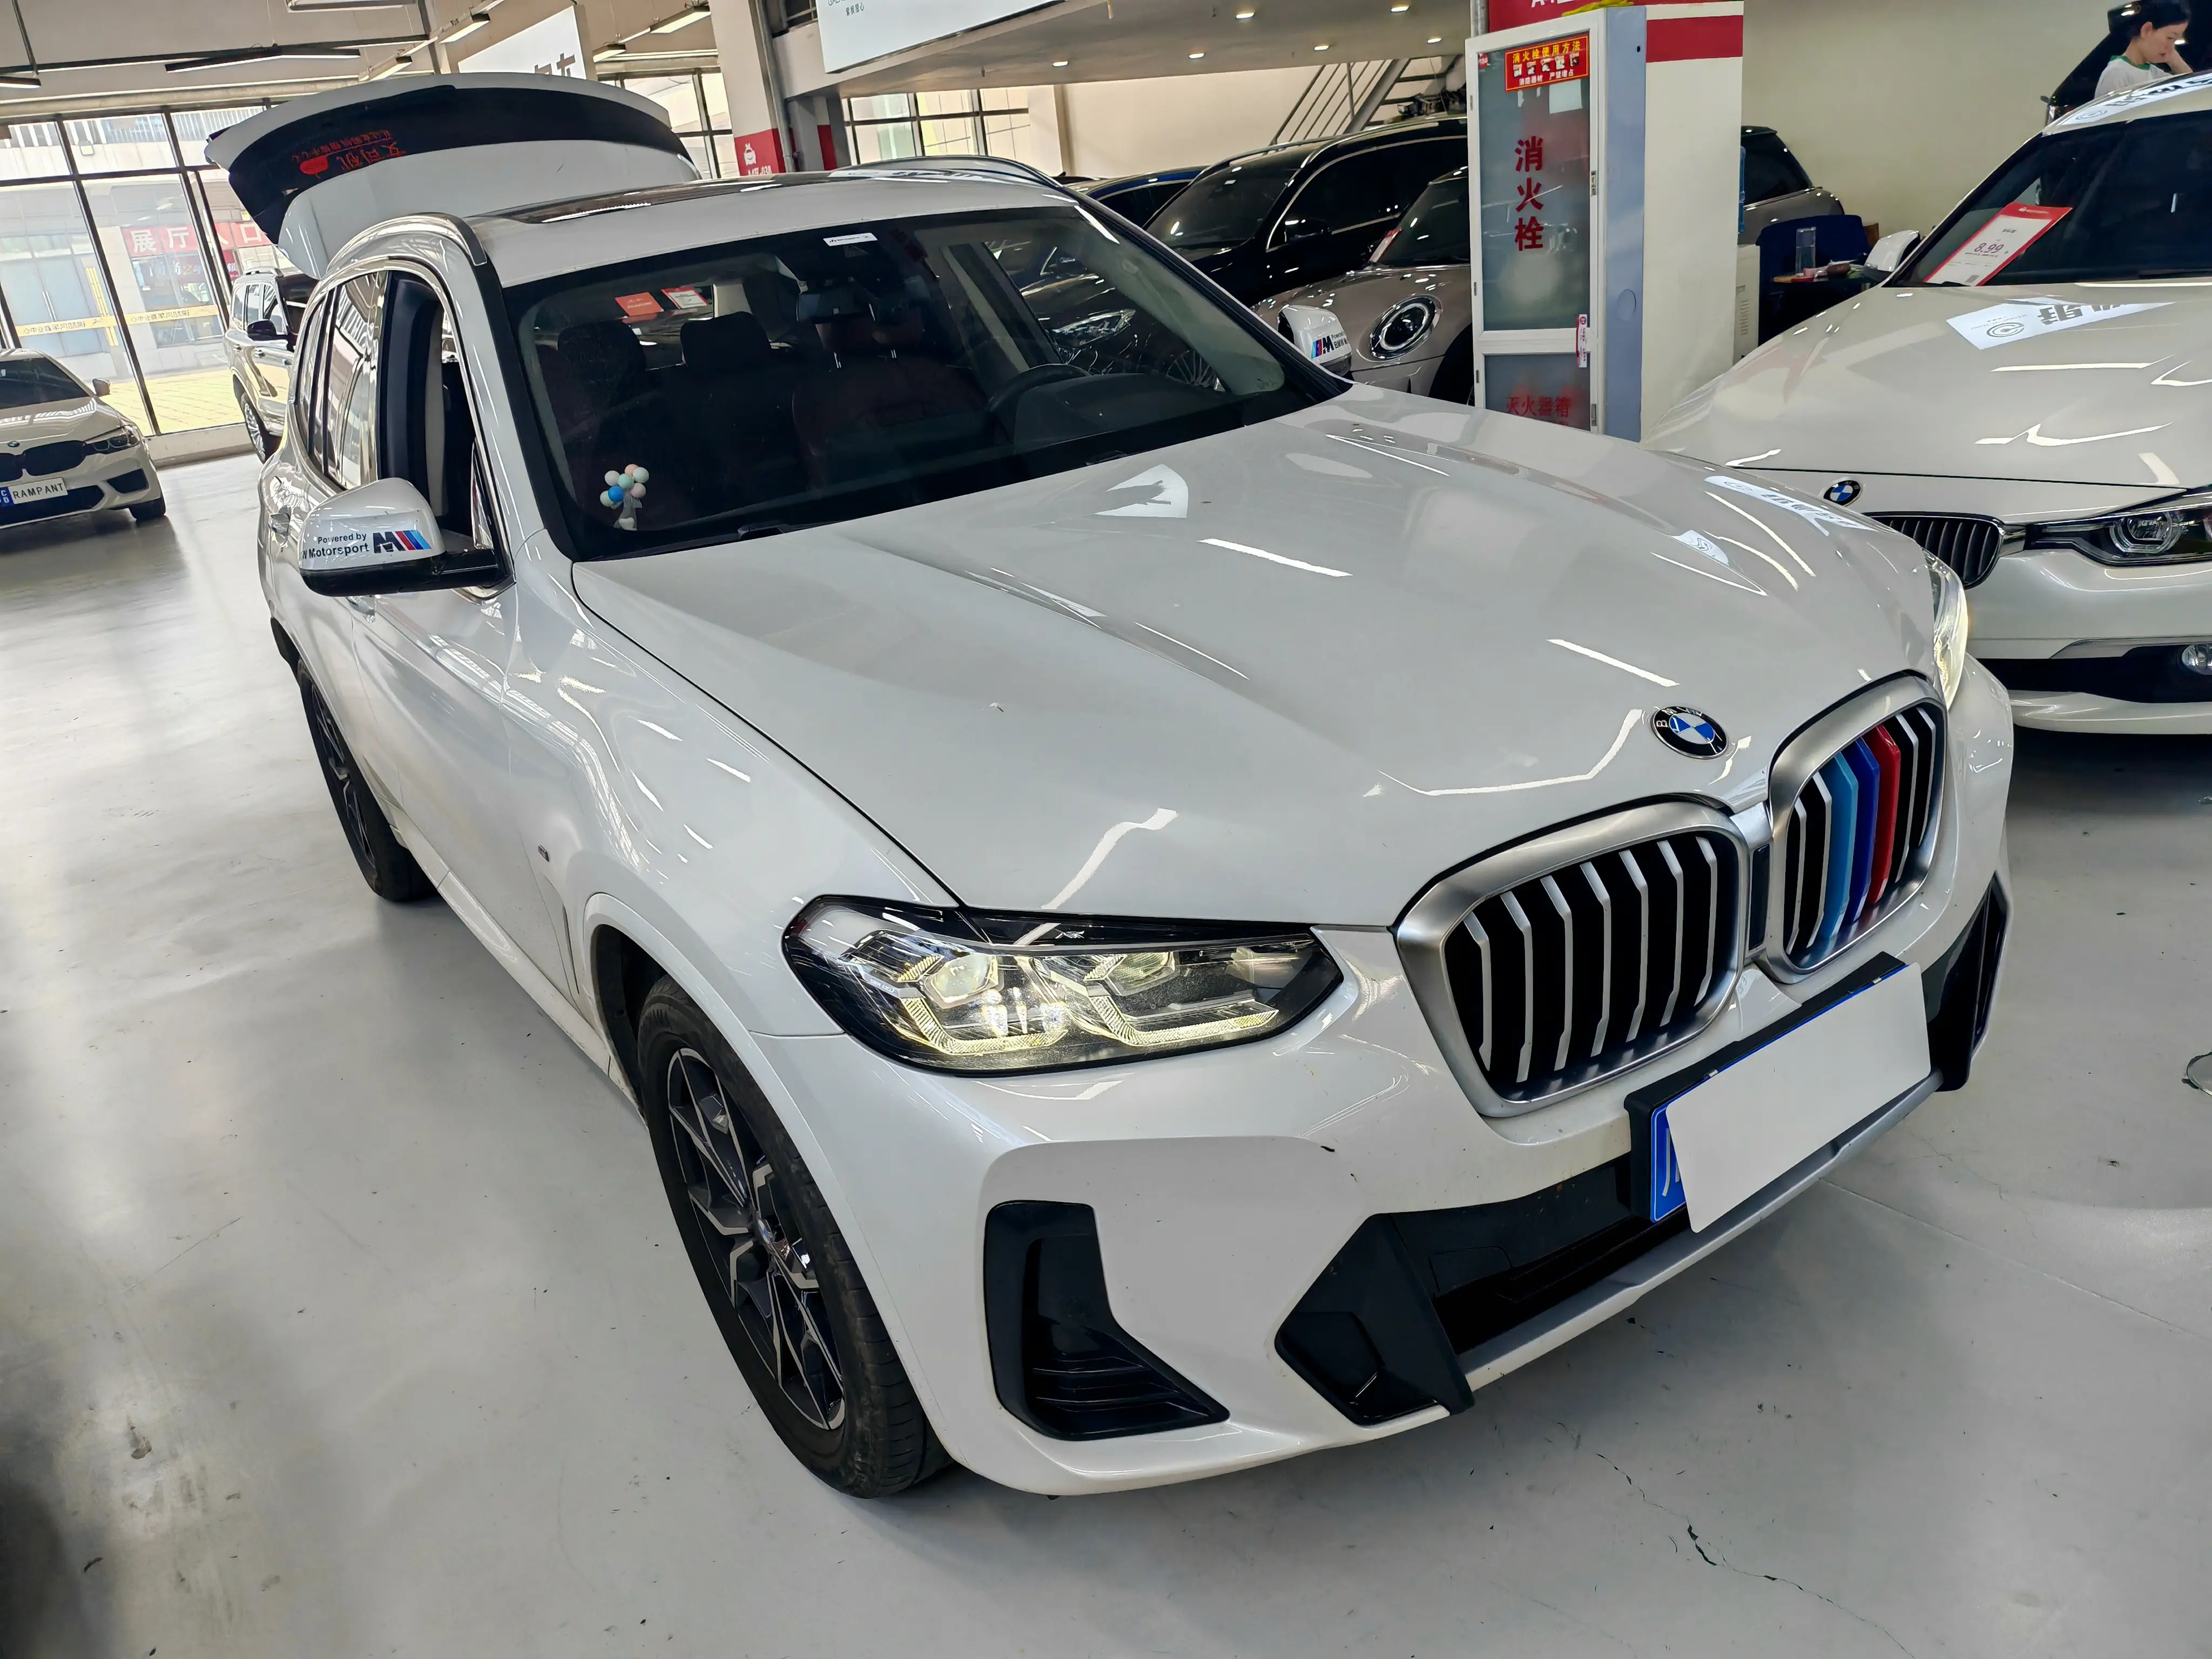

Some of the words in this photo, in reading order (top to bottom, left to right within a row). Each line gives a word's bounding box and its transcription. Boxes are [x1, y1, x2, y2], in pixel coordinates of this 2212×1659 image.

[1513, 41, 1581, 64] 消火栓使用方法
[1514, 136, 1544, 251] 消火栓
[1974, 242, 2004, 253] 8.99
[1505, 395, 1571, 418] 灭火器箱
[12, 483, 63, 500] RAMPANT
[318, 533, 354, 544] Powered
[356, 532, 367, 541] by
[308, 543, 369, 559] Motorsport
